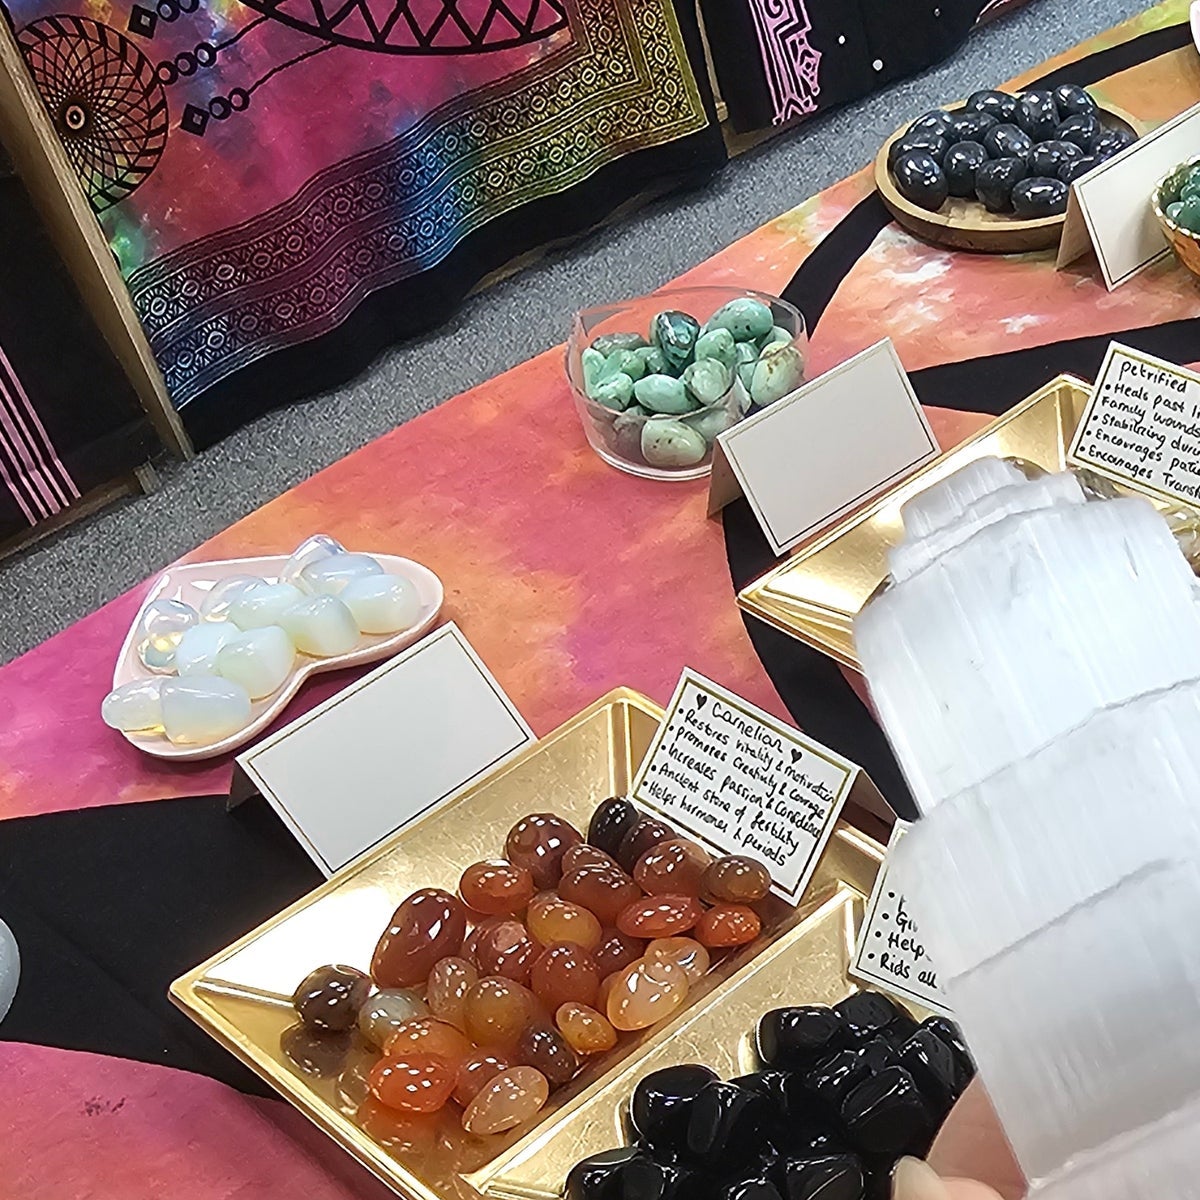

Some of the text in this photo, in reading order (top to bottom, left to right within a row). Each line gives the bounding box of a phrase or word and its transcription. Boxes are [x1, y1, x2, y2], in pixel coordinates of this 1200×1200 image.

[1152, 394, 1185, 413] past
[1095, 428, 1163, 462] Encourages
[684, 708, 730, 745] Restores
[648, 781, 676, 806] Helps
[658, 762, 700, 793] Ancient
[734, 805, 745, 824] of
[880, 952, 910, 979] Rids
[917, 970, 937, 989] all
